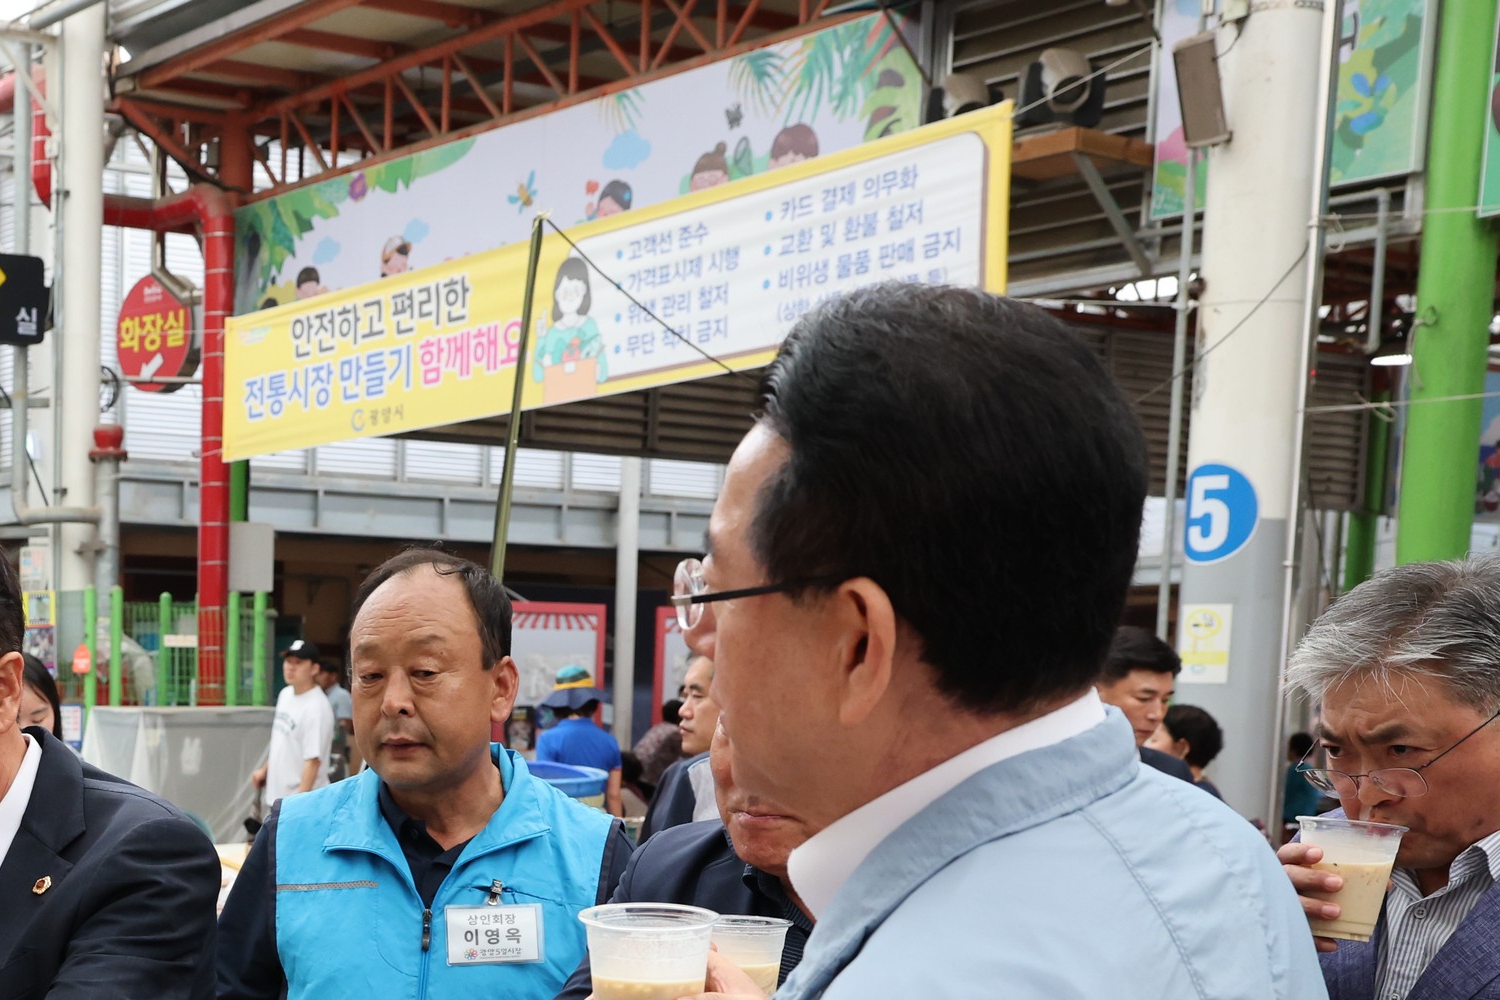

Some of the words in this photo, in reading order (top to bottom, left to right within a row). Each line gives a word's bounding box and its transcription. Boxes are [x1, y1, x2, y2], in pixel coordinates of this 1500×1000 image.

[780, 194, 813, 220] 카드
[822, 180, 856, 212] 결제
[863, 164, 918, 198] 의무화
[628, 230, 673, 260] 고객선
[678, 221, 709, 249] 준수
[778, 227, 813, 256] 교환
[821, 221, 836, 248] 및
[844, 212, 878, 242] 환불
[888, 200, 924, 232] 철저
[628, 256, 702, 292] 가격표시제
[708, 245, 740, 272] 시행
[778, 258, 829, 290] 비위생
[836, 249, 870, 279] 물품
[880, 238, 915, 269] 판매
[924, 227, 961, 260] 금지
[292, 300, 385, 359] 안전하고
[391, 275, 470, 335] 편리한
[662, 291, 692, 318] 관리
[699, 282, 729, 310] 철저
[119, 309, 185, 353] 화장실
[627, 332, 655, 357] 무단
[698, 315, 728, 344] 금지
[244, 362, 334, 420] 전통시장
[339, 345, 412, 400] 만들기
[419, 320, 524, 386] 함께해요
[368, 404, 405, 427] 광양시
[1187, 473, 1231, 553] 5
[464, 928, 522, 946] 이영옥
[468, 913, 516, 925] 상인회장
